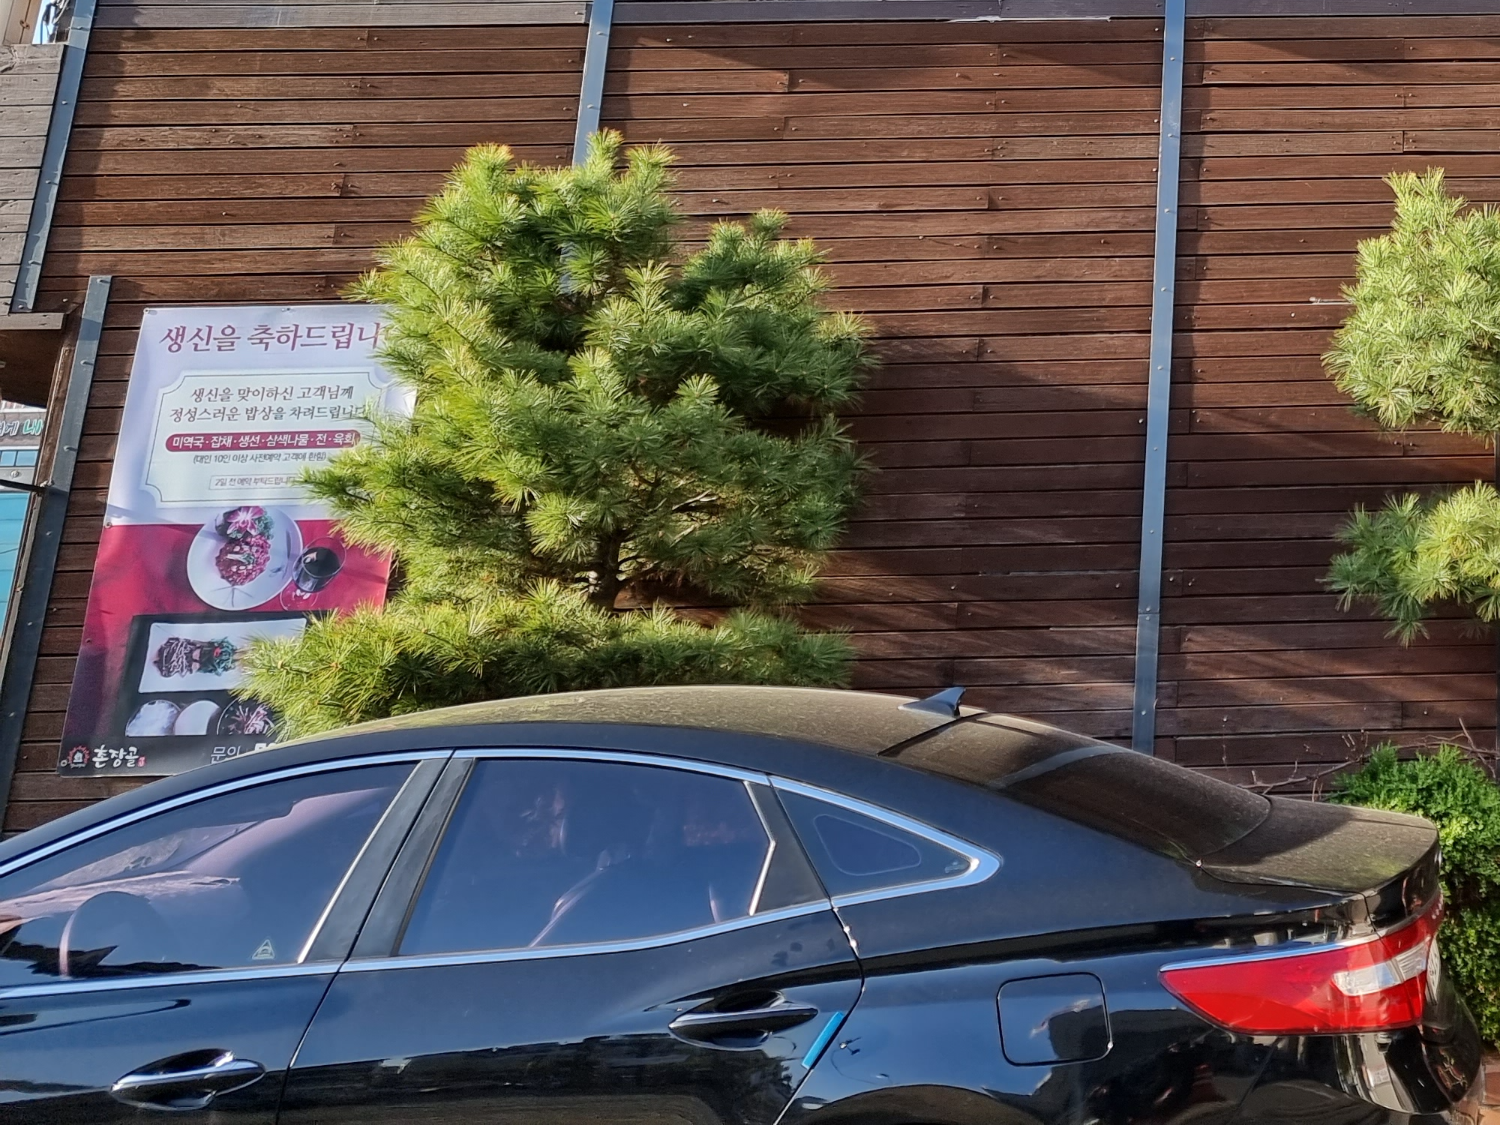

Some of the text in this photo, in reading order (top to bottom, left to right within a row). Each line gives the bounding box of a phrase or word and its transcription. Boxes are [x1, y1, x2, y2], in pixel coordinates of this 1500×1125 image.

[159, 322, 385, 353] 생신을 축하드립니
[191, 385, 354, 403] 생신을 맞이하신 고객님께
[169, 407, 241, 423] 정성스러운
[245, 406, 287, 422] 밥상을
